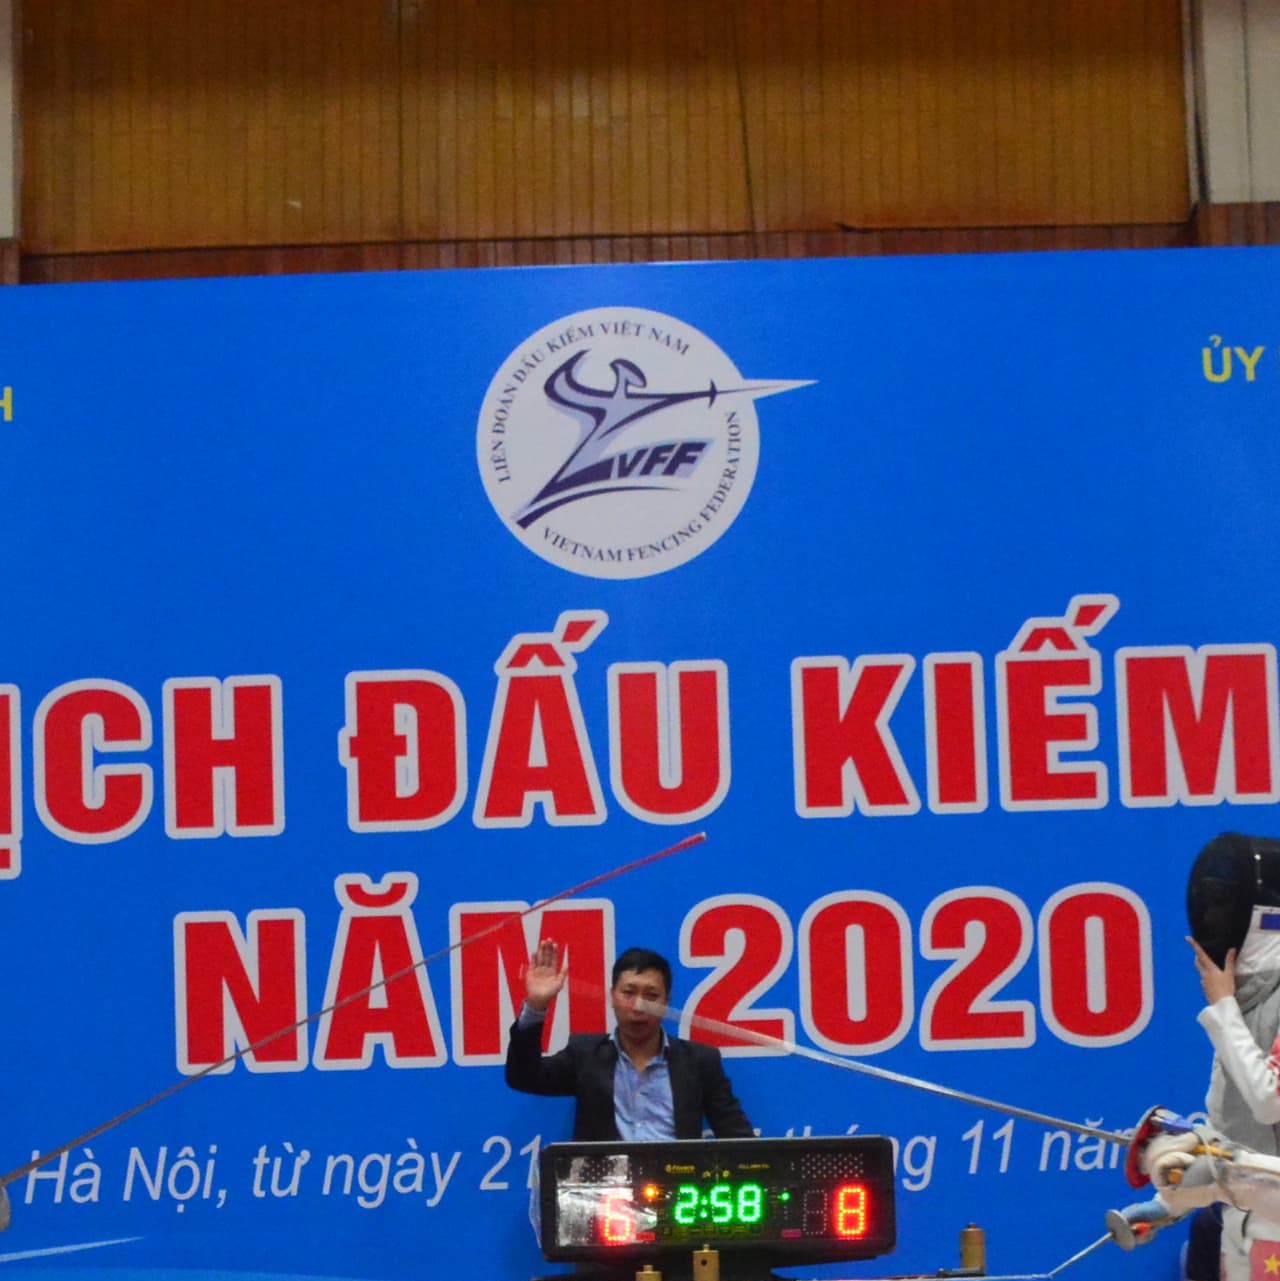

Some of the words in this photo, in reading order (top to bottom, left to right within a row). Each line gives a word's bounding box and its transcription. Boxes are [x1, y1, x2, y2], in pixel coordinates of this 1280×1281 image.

[648, 327, 691, 356] NAM
[1202, 334, 1265, 383] ỦY
[543, 527, 622, 562] VIETNAM
[627, 519, 703, 562] FENCING
[700, 411, 741, 523] FEDERATION
[617, 442, 708, 479] VFF
[337, 609, 731, 833] ĐẤU
[173, 871, 616, 1075] NĂM
[678, 880, 1153, 1058] 2020
[23, 1146, 102, 1204] Hà
[123, 1143, 228, 1213] Nội,
[252, 1141, 311, 1198] từ
[322, 1137, 462, 1209] ngày
[479, 1134, 544, 1191] 21
[960, 1118, 1015, 1175] 11
[674, 1184, 761, 1224] 2:58
[836, 1186, 866, 1237] 8
